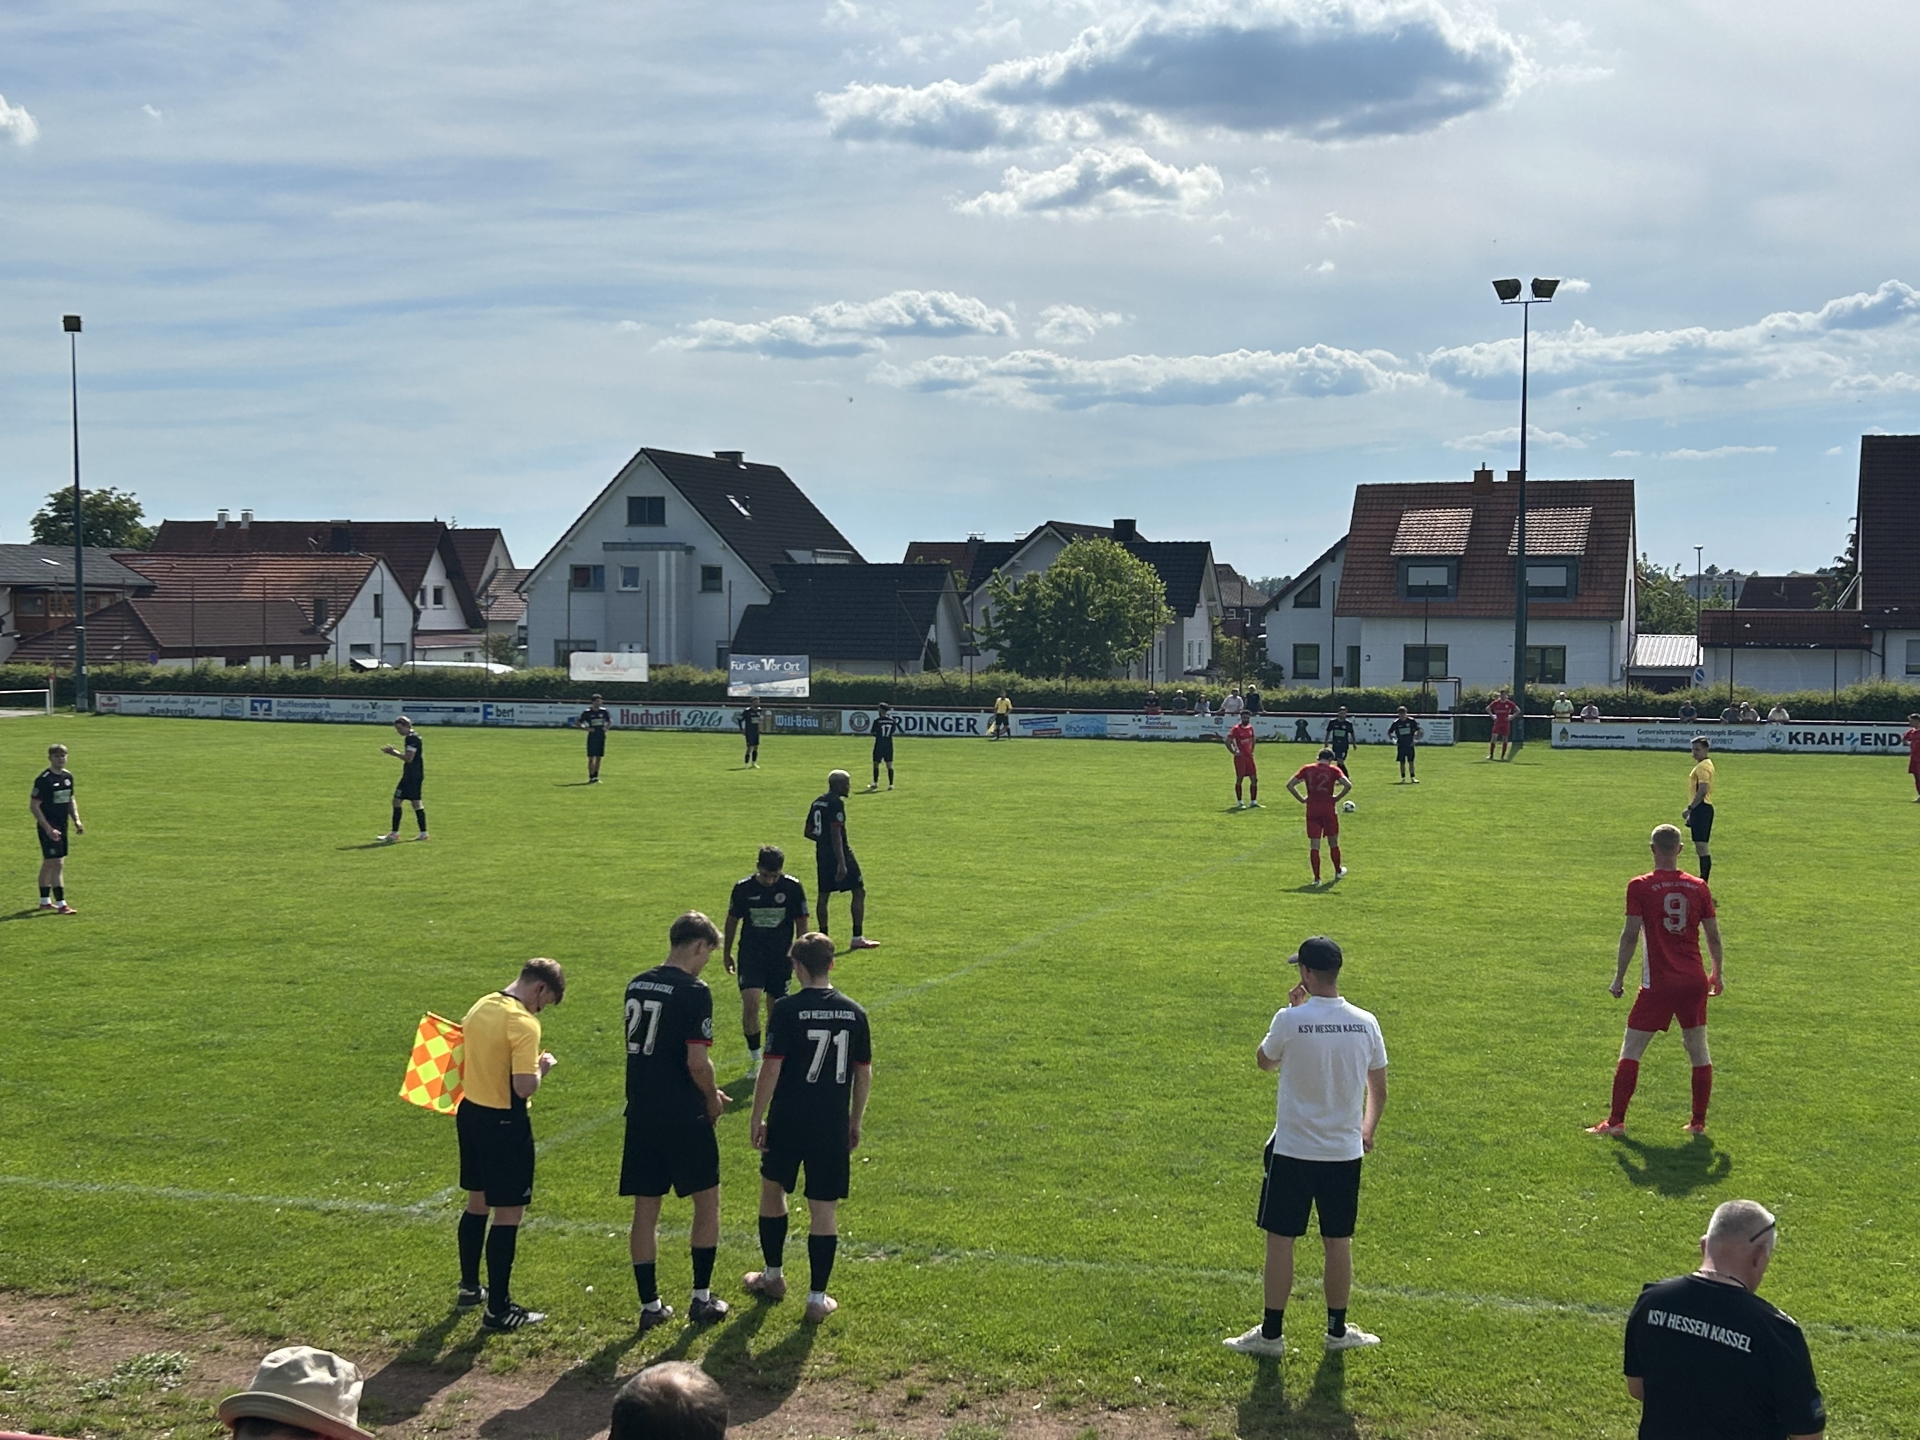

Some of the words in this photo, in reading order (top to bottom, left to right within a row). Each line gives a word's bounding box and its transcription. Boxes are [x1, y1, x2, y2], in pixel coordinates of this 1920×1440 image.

[730, 660, 745, 670] Für
[747, 661, 760, 671] Sie
[761, 658, 781, 671] Vor
[783, 661, 800, 671] Ort
[1365, 654, 1371, 662] 3
[482, 704, 515, 724] Ebert
[620, 709, 681, 726] Hochstift
[684, 709, 724, 727] Pils
[774, 714, 819, 728] Will-Bräu
[881, 724, 892, 737] 17
[891, 716, 980, 734] RDINGER
[1788, 732, 1844, 746] KRAH
[814, 809, 823, 837] 9
[1663, 892, 1689, 935] 9
[811, 1010, 834, 1020] HESSEN
[834, 1010, 856, 1020] KASSEL
[625, 997, 663, 1056] 27
[1298, 1024, 1314, 1034] KSV
[1315, 1024, 1342, 1034] HESSEN
[1343, 1024, 1368, 1034] KASSEL
[806, 1029, 850, 1084] 71
[1647, 1309, 1667, 1326] KSV
[1667, 1313, 1710, 1339] HESSEN
[1710, 1325, 1752, 1353] KASSEL
